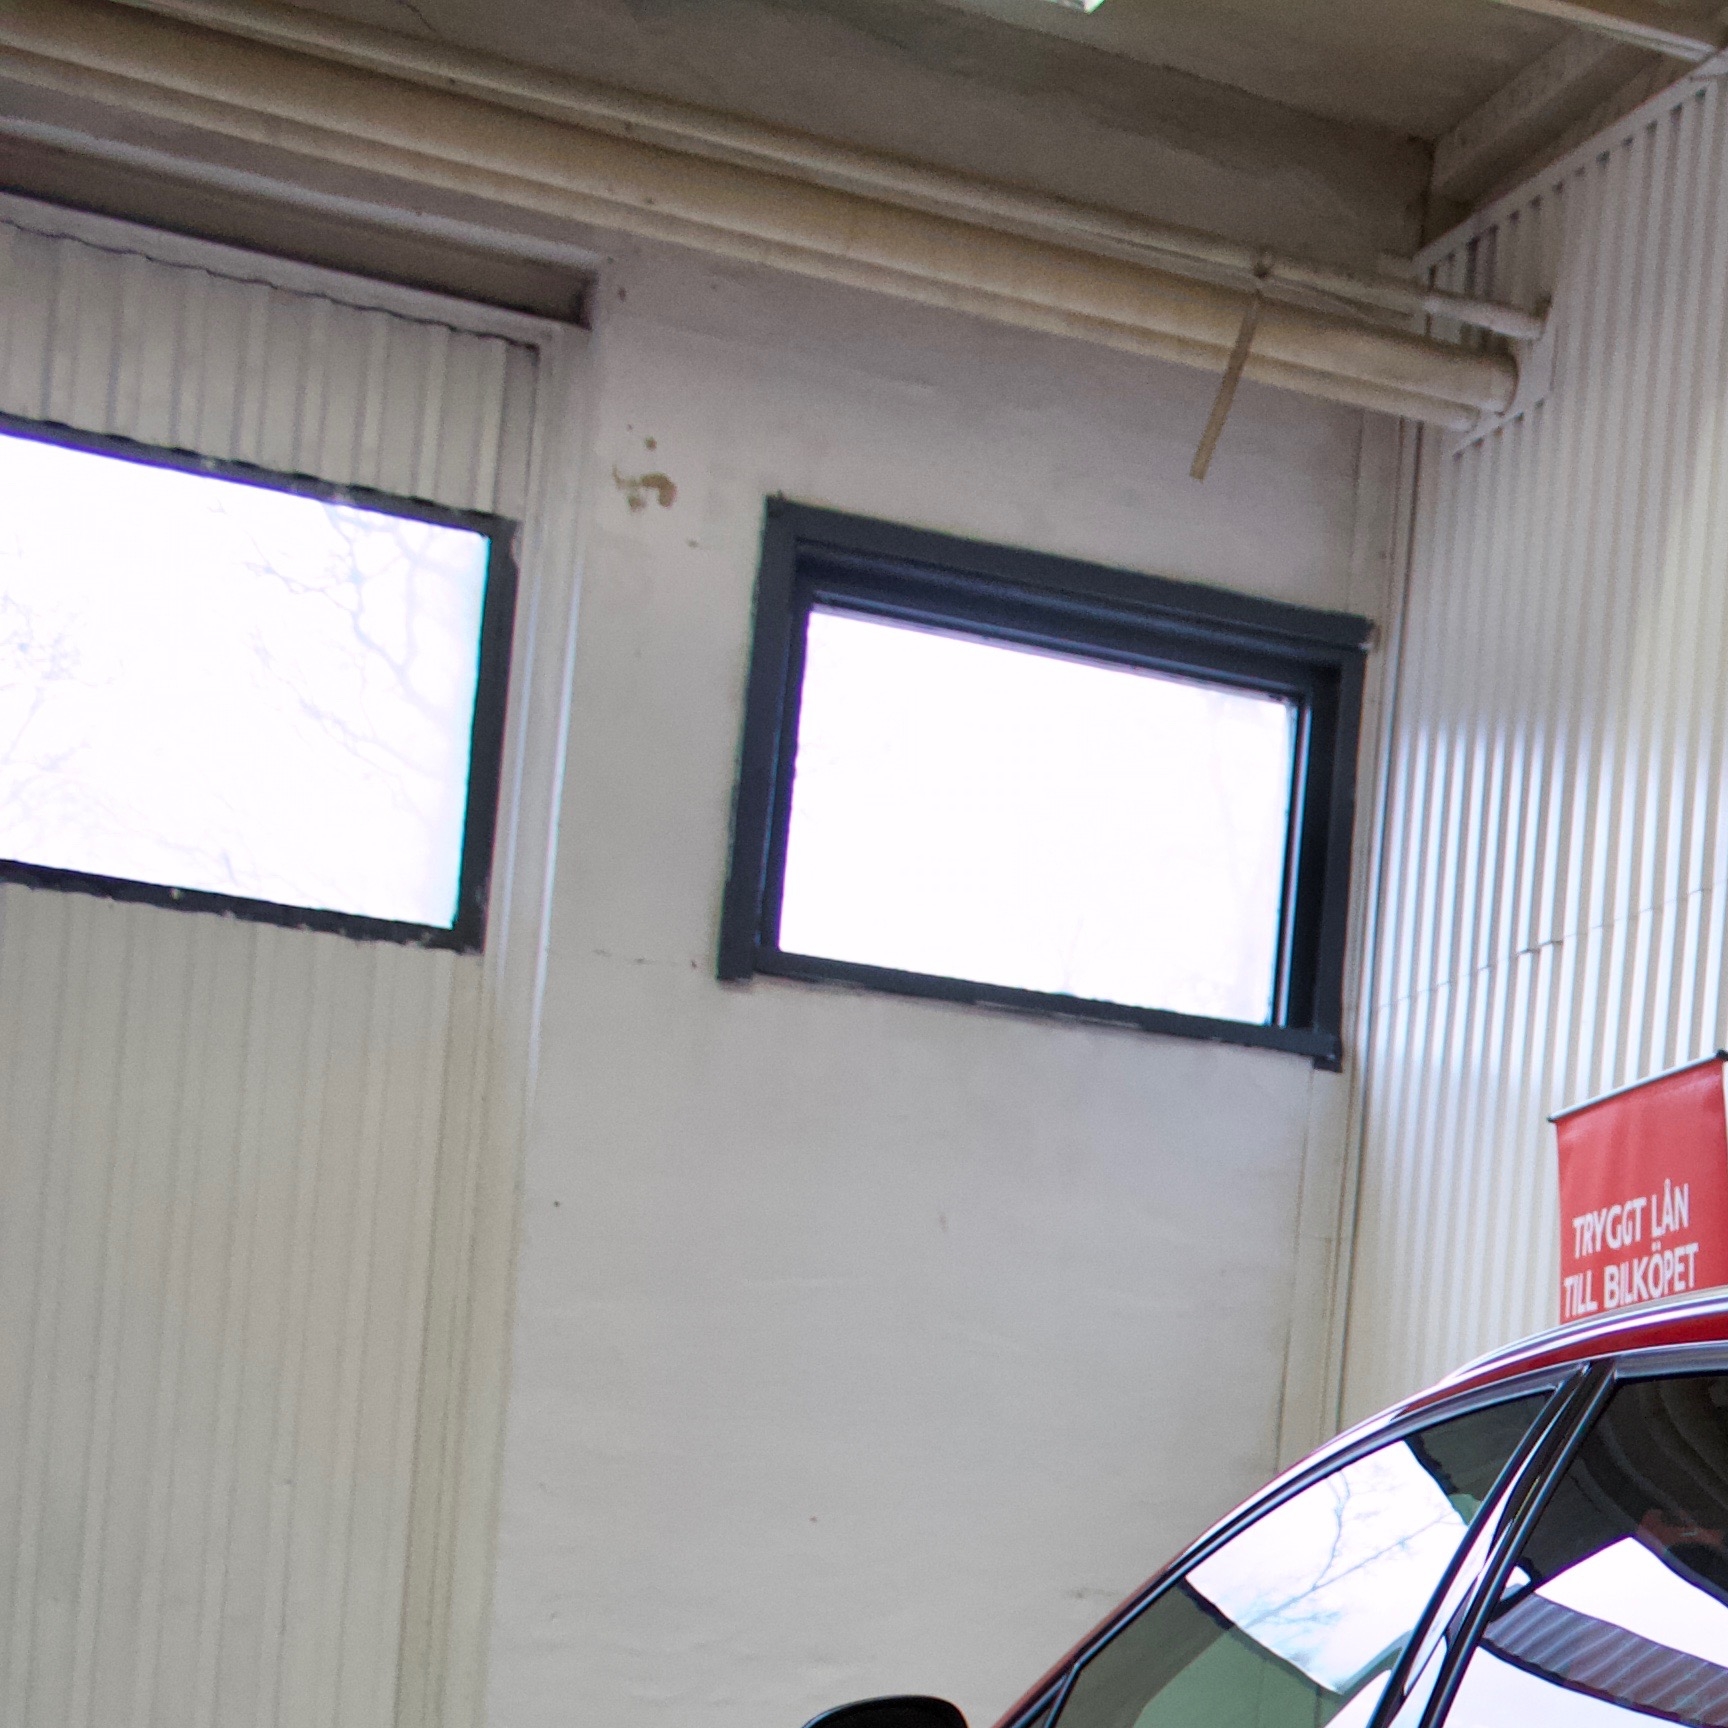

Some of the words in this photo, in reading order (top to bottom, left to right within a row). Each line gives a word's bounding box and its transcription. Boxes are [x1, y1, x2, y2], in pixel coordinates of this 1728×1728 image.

[1572, 1196, 1648, 1260] TRYGGT
[1651, 1178, 1690, 1239] LÅN
[1563, 1269, 1599, 1319] TILL
[1603, 1241, 1700, 1310] BILKÖPET
